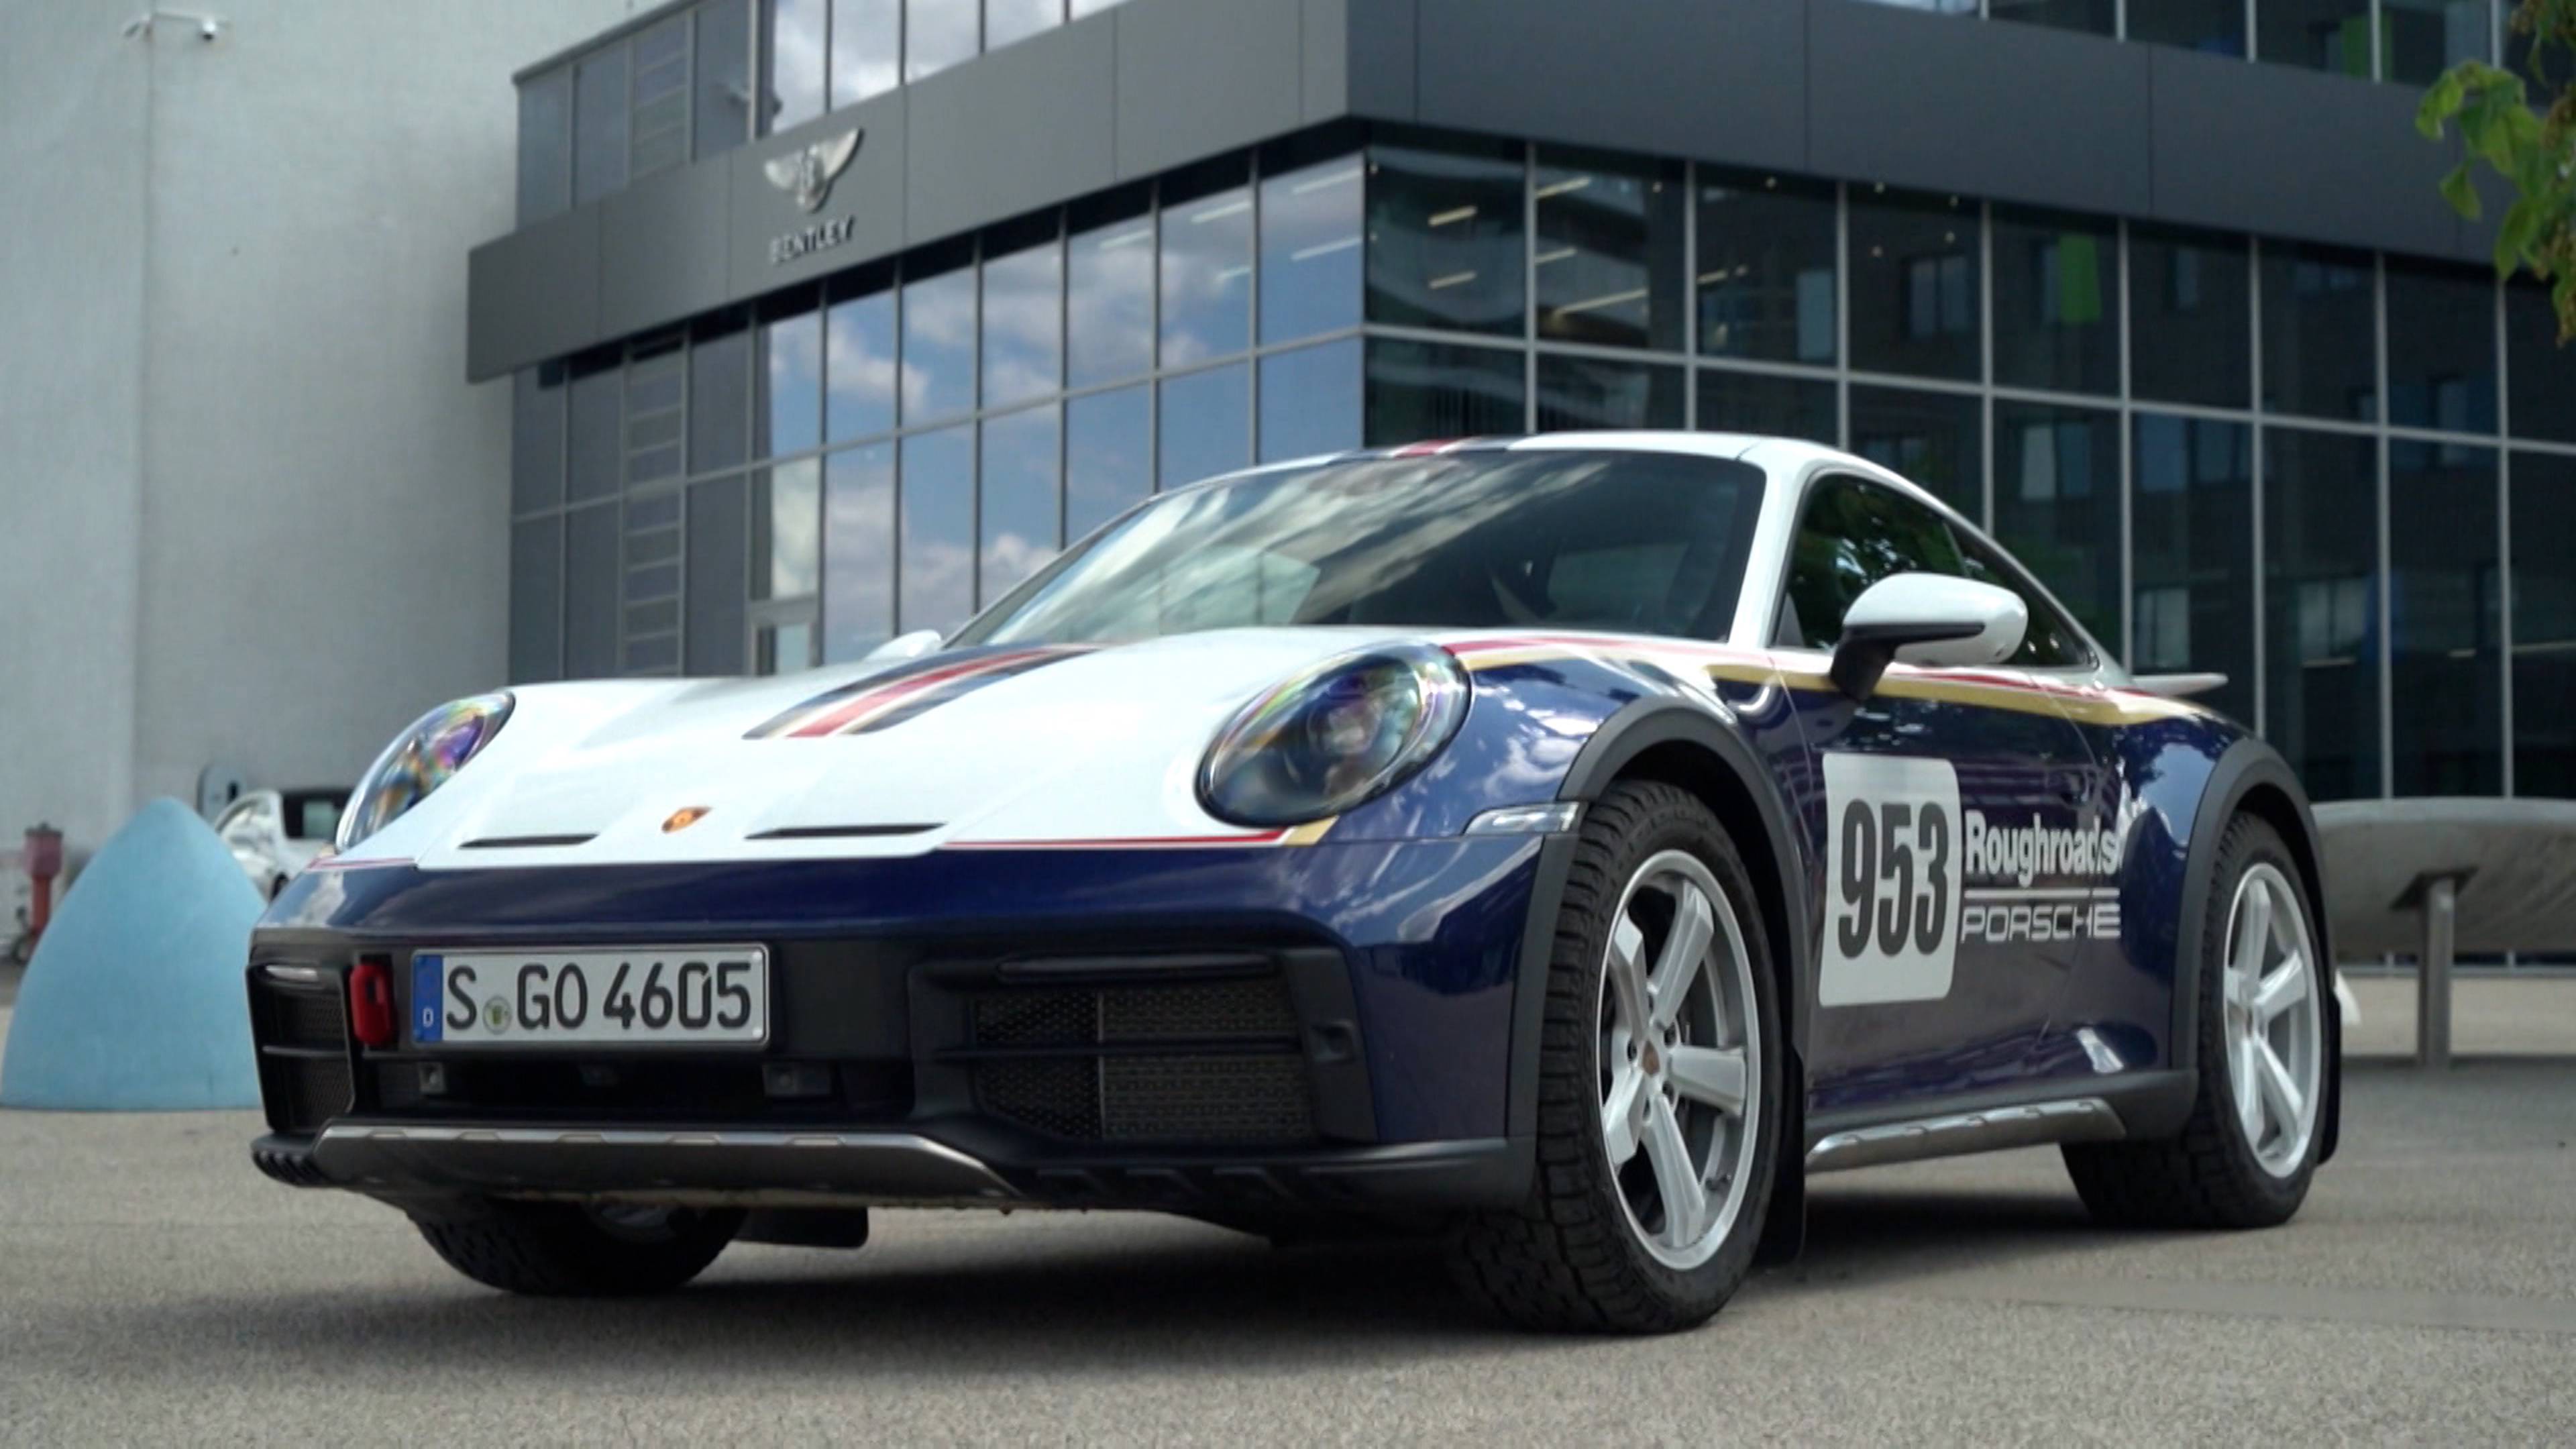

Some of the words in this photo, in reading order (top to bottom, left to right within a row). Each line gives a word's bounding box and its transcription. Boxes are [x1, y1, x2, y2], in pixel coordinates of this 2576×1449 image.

[771, 215, 854, 264] BENTLEY
[1965, 810, 2120, 888] Roughroads
[1838, 799, 1948, 959] 953
[1962, 903, 2121, 943] PORSCHE
[423, 1008, 433, 1026] D
[446, 965, 477, 1030] S
[517, 963, 588, 1030] GO
[603, 962, 751, 1030] 4605
